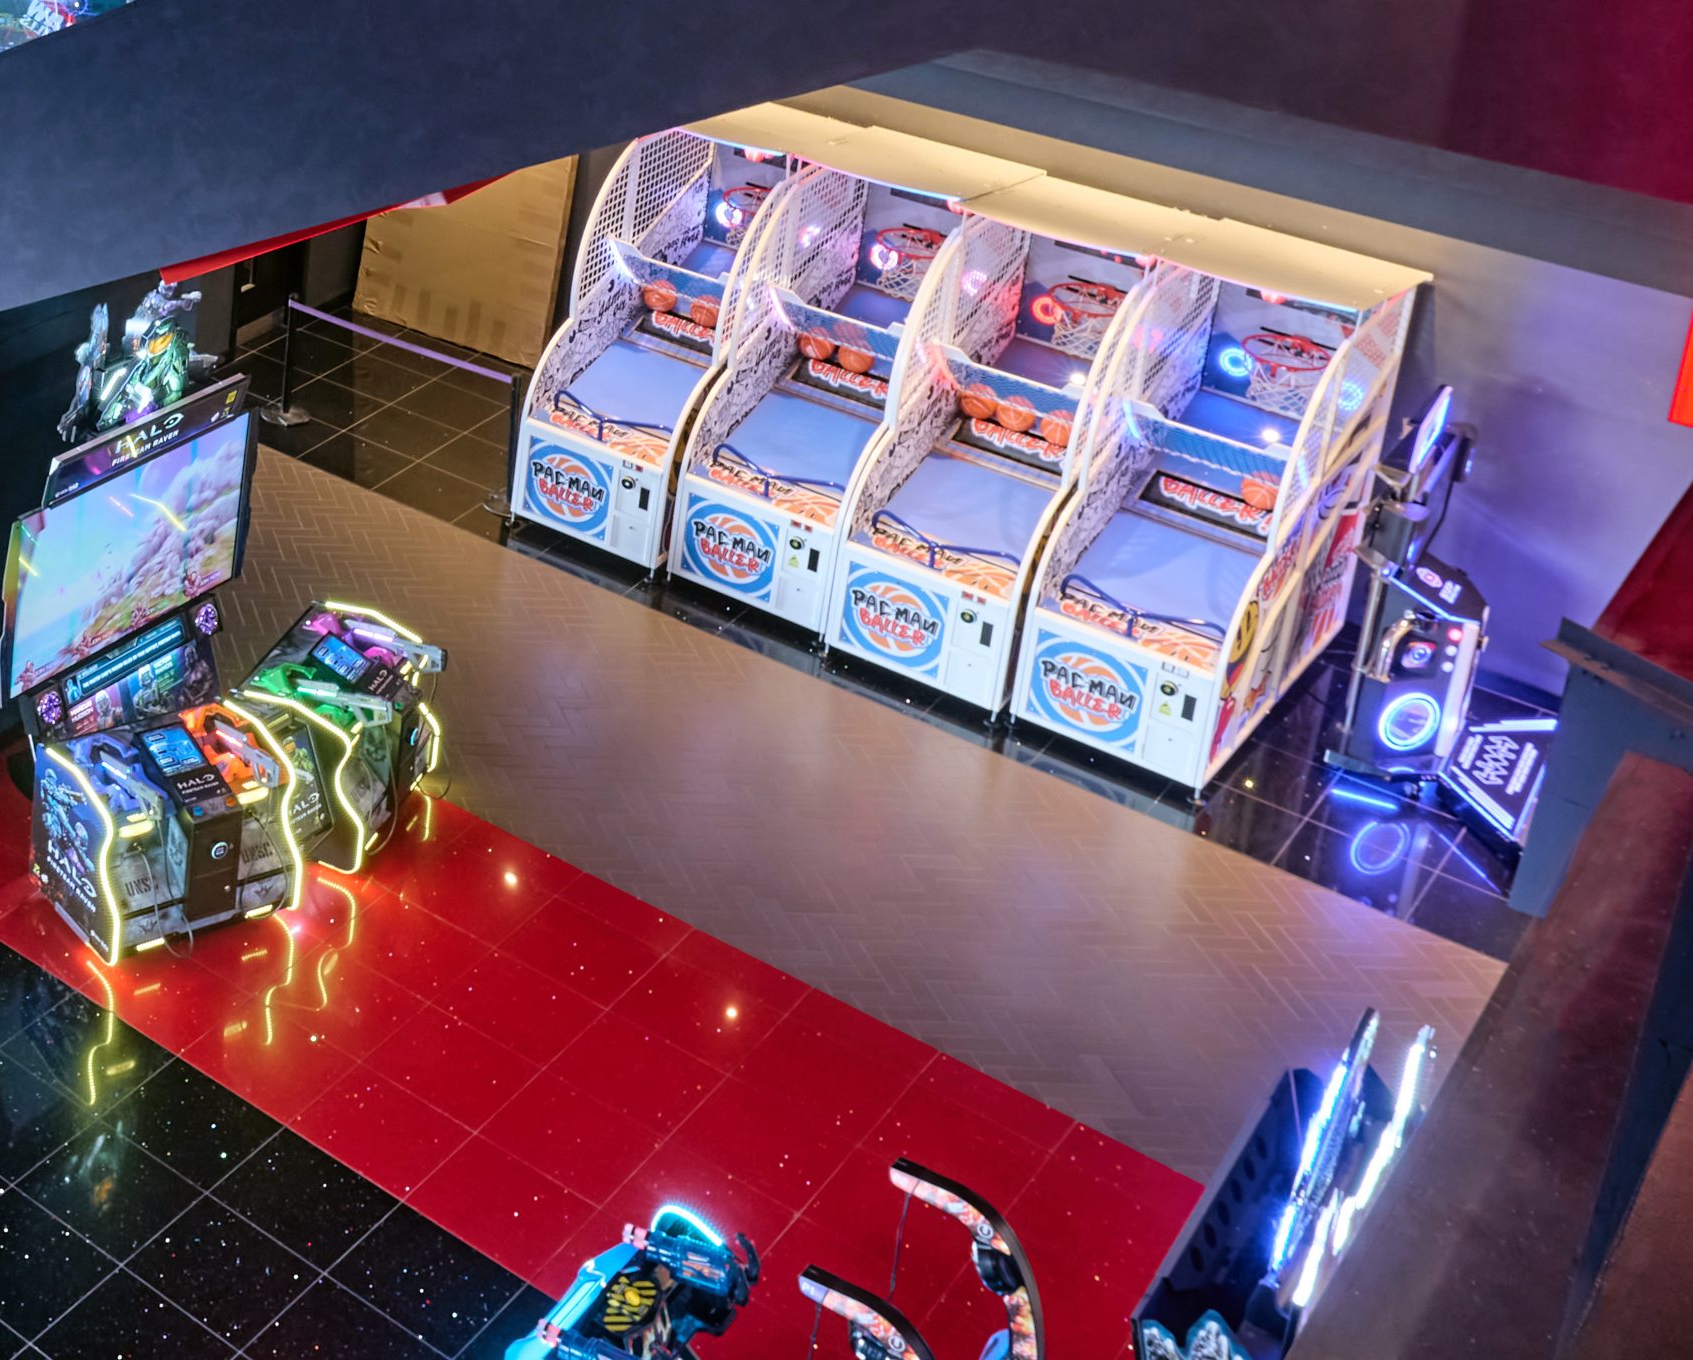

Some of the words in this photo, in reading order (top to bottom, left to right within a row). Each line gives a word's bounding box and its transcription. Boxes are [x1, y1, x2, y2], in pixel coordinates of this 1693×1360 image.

[115, 412, 185, 455] HALO
[152, 429, 179, 452] RAVEN
[176, 773, 215, 790] HALO
[47, 839, 98, 898] HALO
